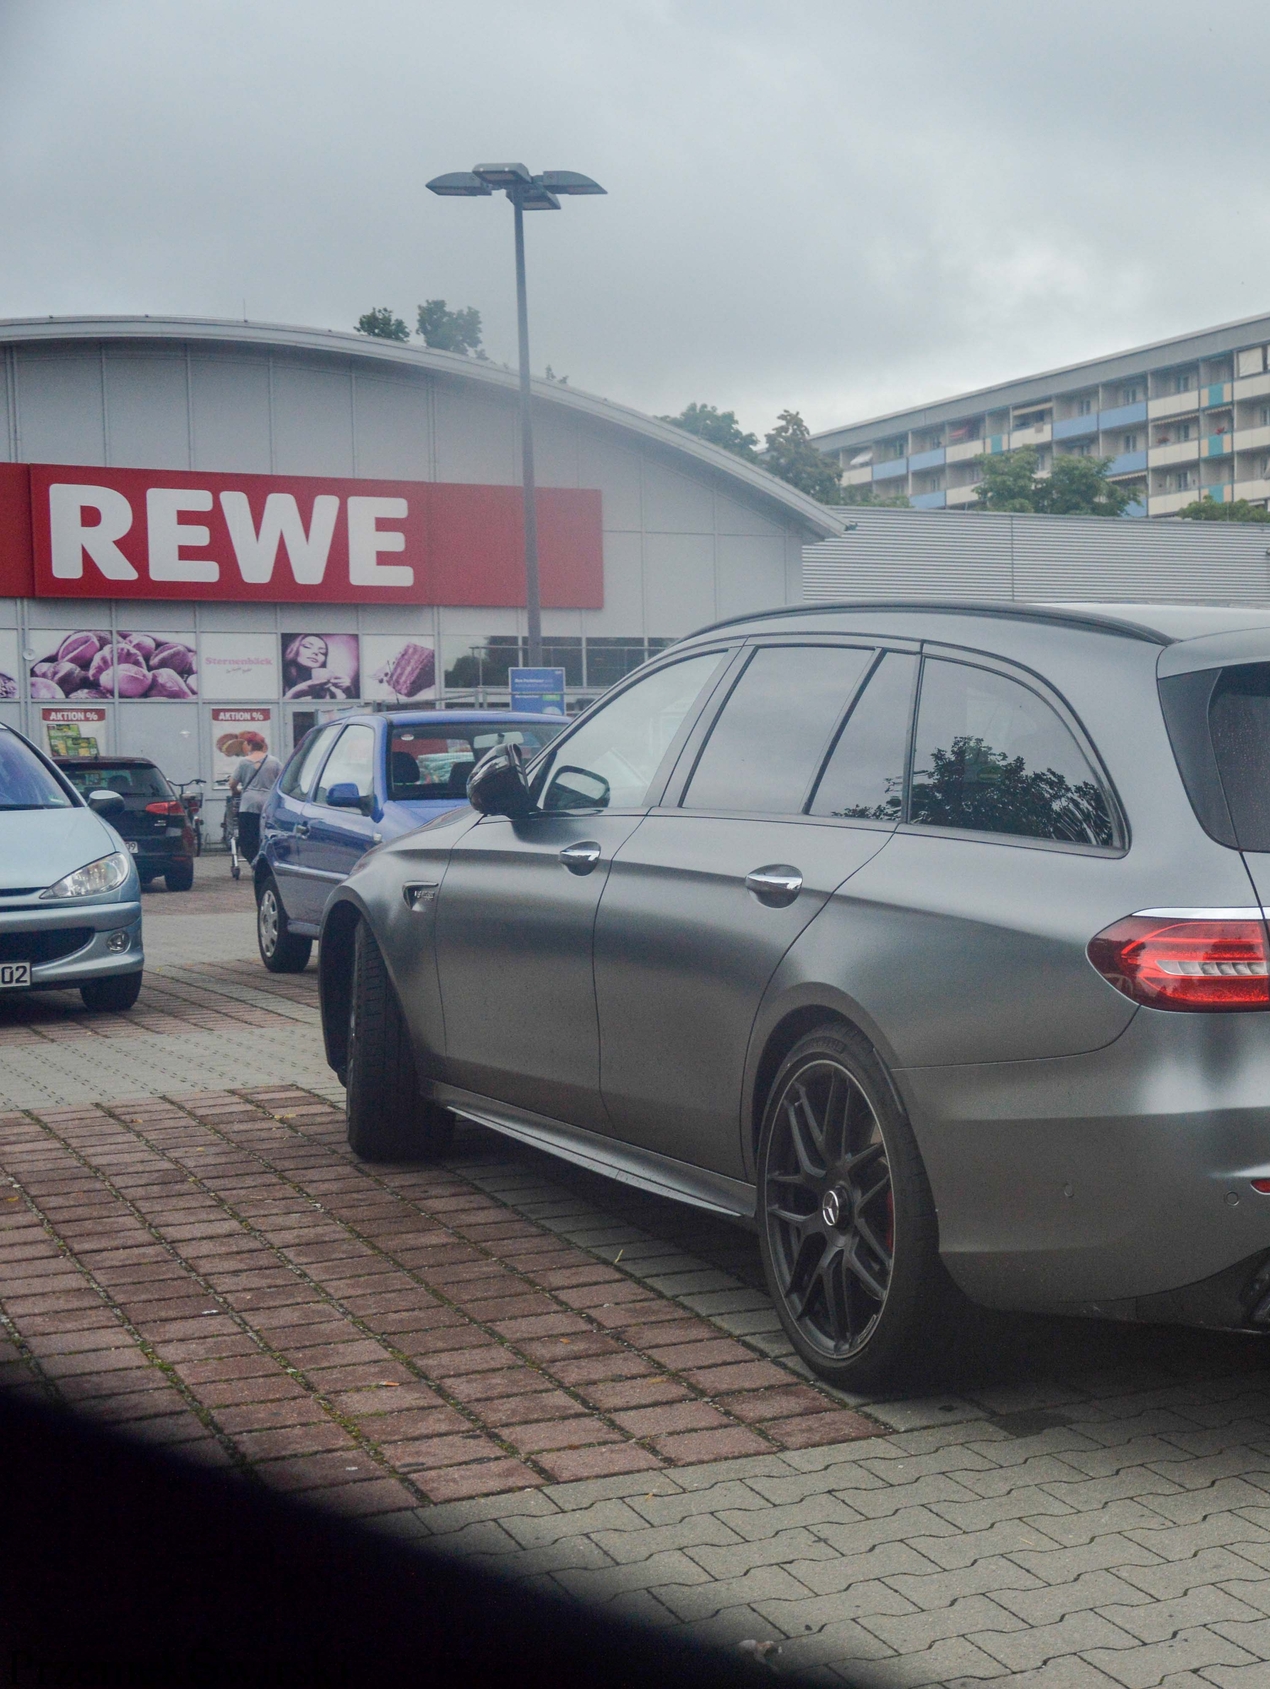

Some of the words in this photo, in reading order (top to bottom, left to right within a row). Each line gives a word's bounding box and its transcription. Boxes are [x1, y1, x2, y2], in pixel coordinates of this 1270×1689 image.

[49, 483, 414, 587] REWE
[50, 711, 85, 720] AKTION
[86, 711, 98, 720] %
[218, 711, 251, 720] AKTION
[252, 712, 263, 720] %
[1, 965, 28, 984] 02
